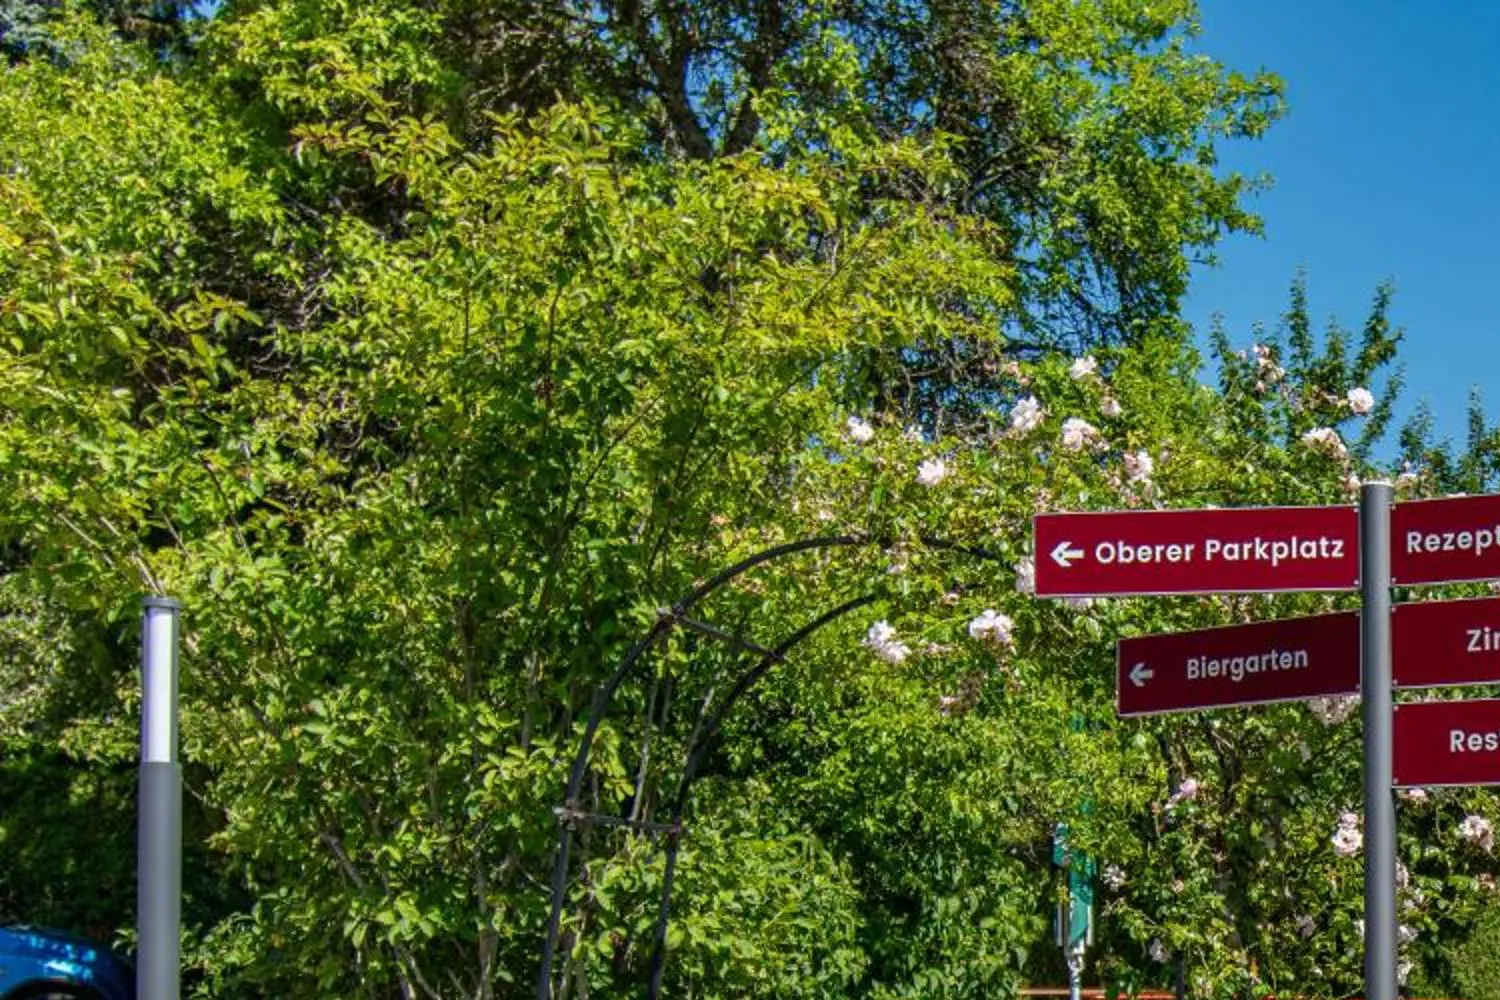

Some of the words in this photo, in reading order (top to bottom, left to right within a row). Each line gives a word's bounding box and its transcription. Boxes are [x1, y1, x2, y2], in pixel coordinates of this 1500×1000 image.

[1095, 540, 1195, 564] Oberer
[1205, 535, 1345, 567] Parkplatz
[1187, 649, 1308, 682] Biergarten
